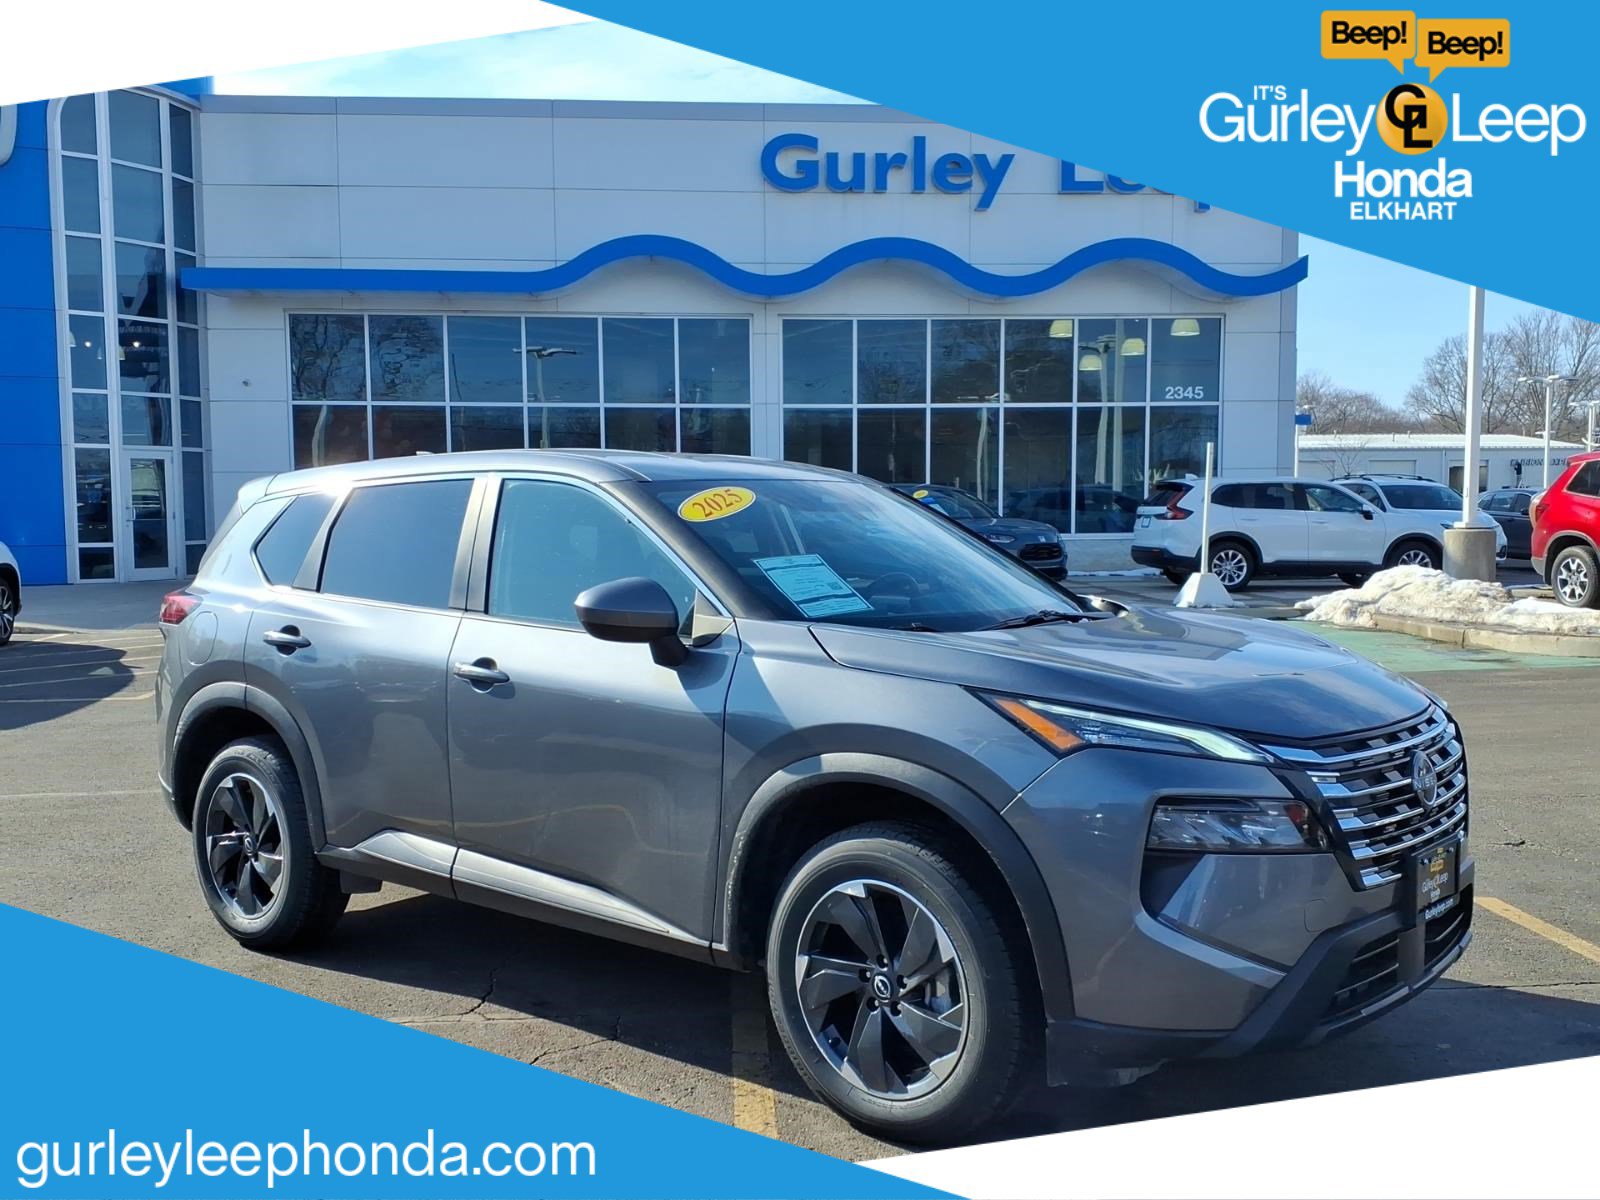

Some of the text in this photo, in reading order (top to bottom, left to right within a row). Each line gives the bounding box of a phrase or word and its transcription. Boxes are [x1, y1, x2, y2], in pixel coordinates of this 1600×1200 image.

[760, 133, 1016, 211] Gurley
[1165, 385, 1204, 399] 2345
[692, 489, 743, 518] 2025
